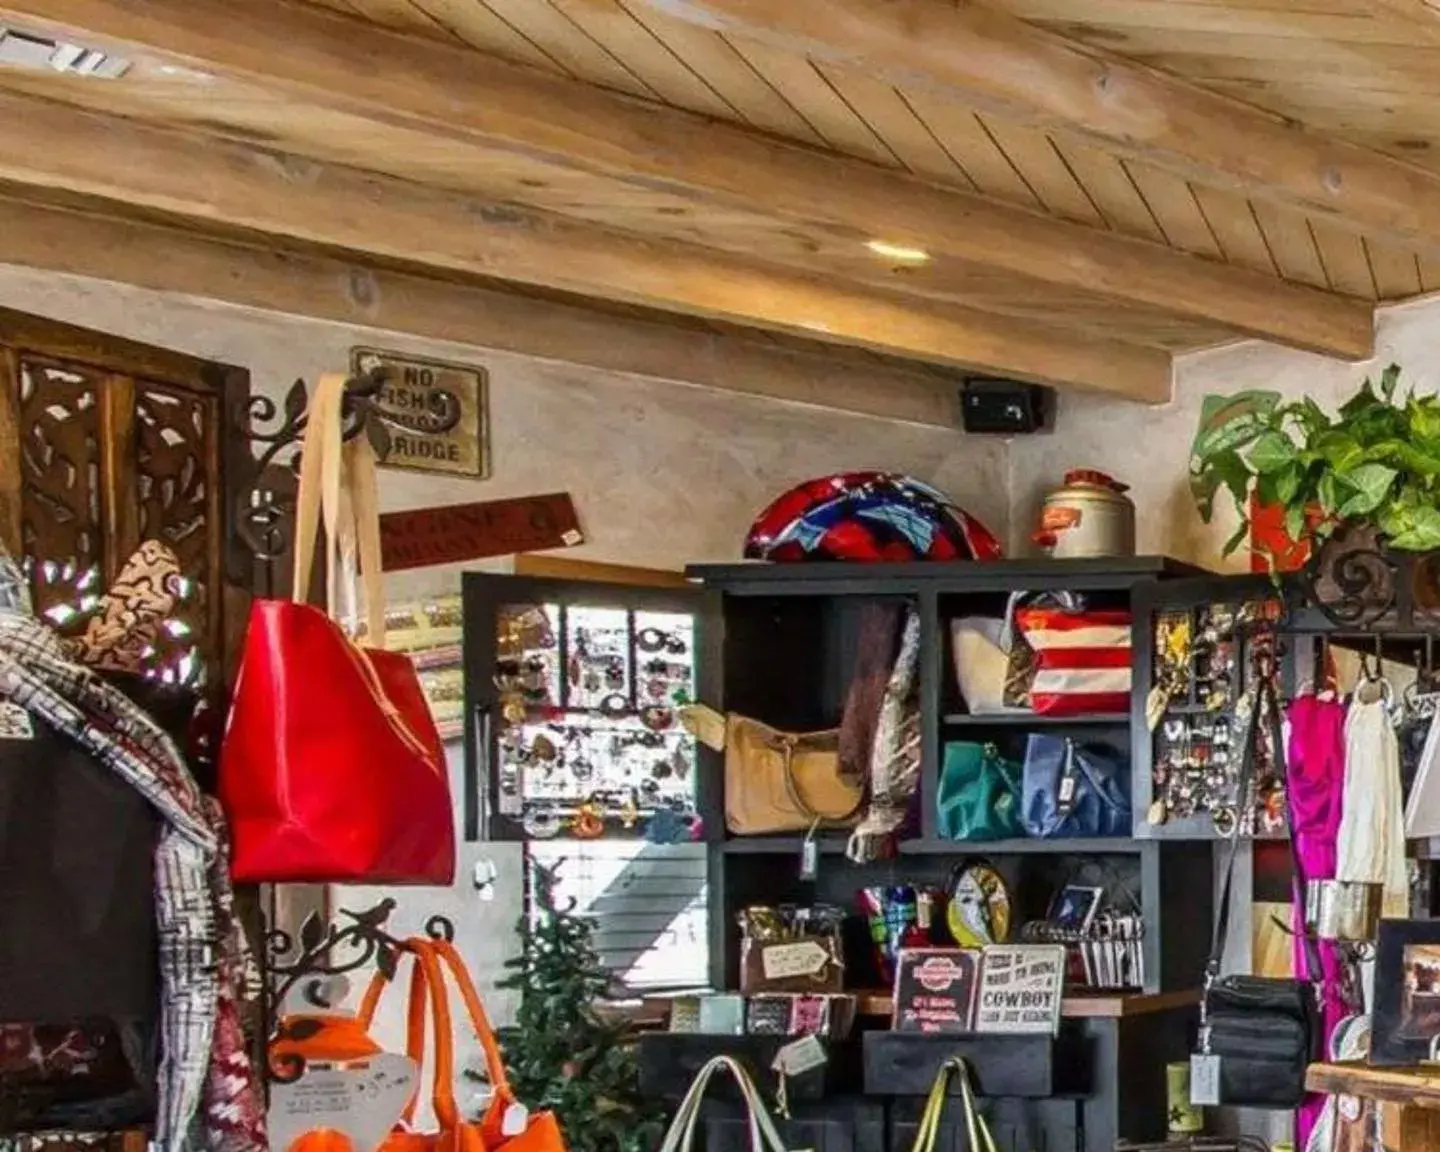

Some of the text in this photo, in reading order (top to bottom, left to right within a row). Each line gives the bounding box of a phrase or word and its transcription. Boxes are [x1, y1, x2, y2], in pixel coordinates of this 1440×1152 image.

[403, 366, 434, 387] NO
[393, 437, 460, 462] RIDGE
[983, 990, 1053, 1008] COWBOY
